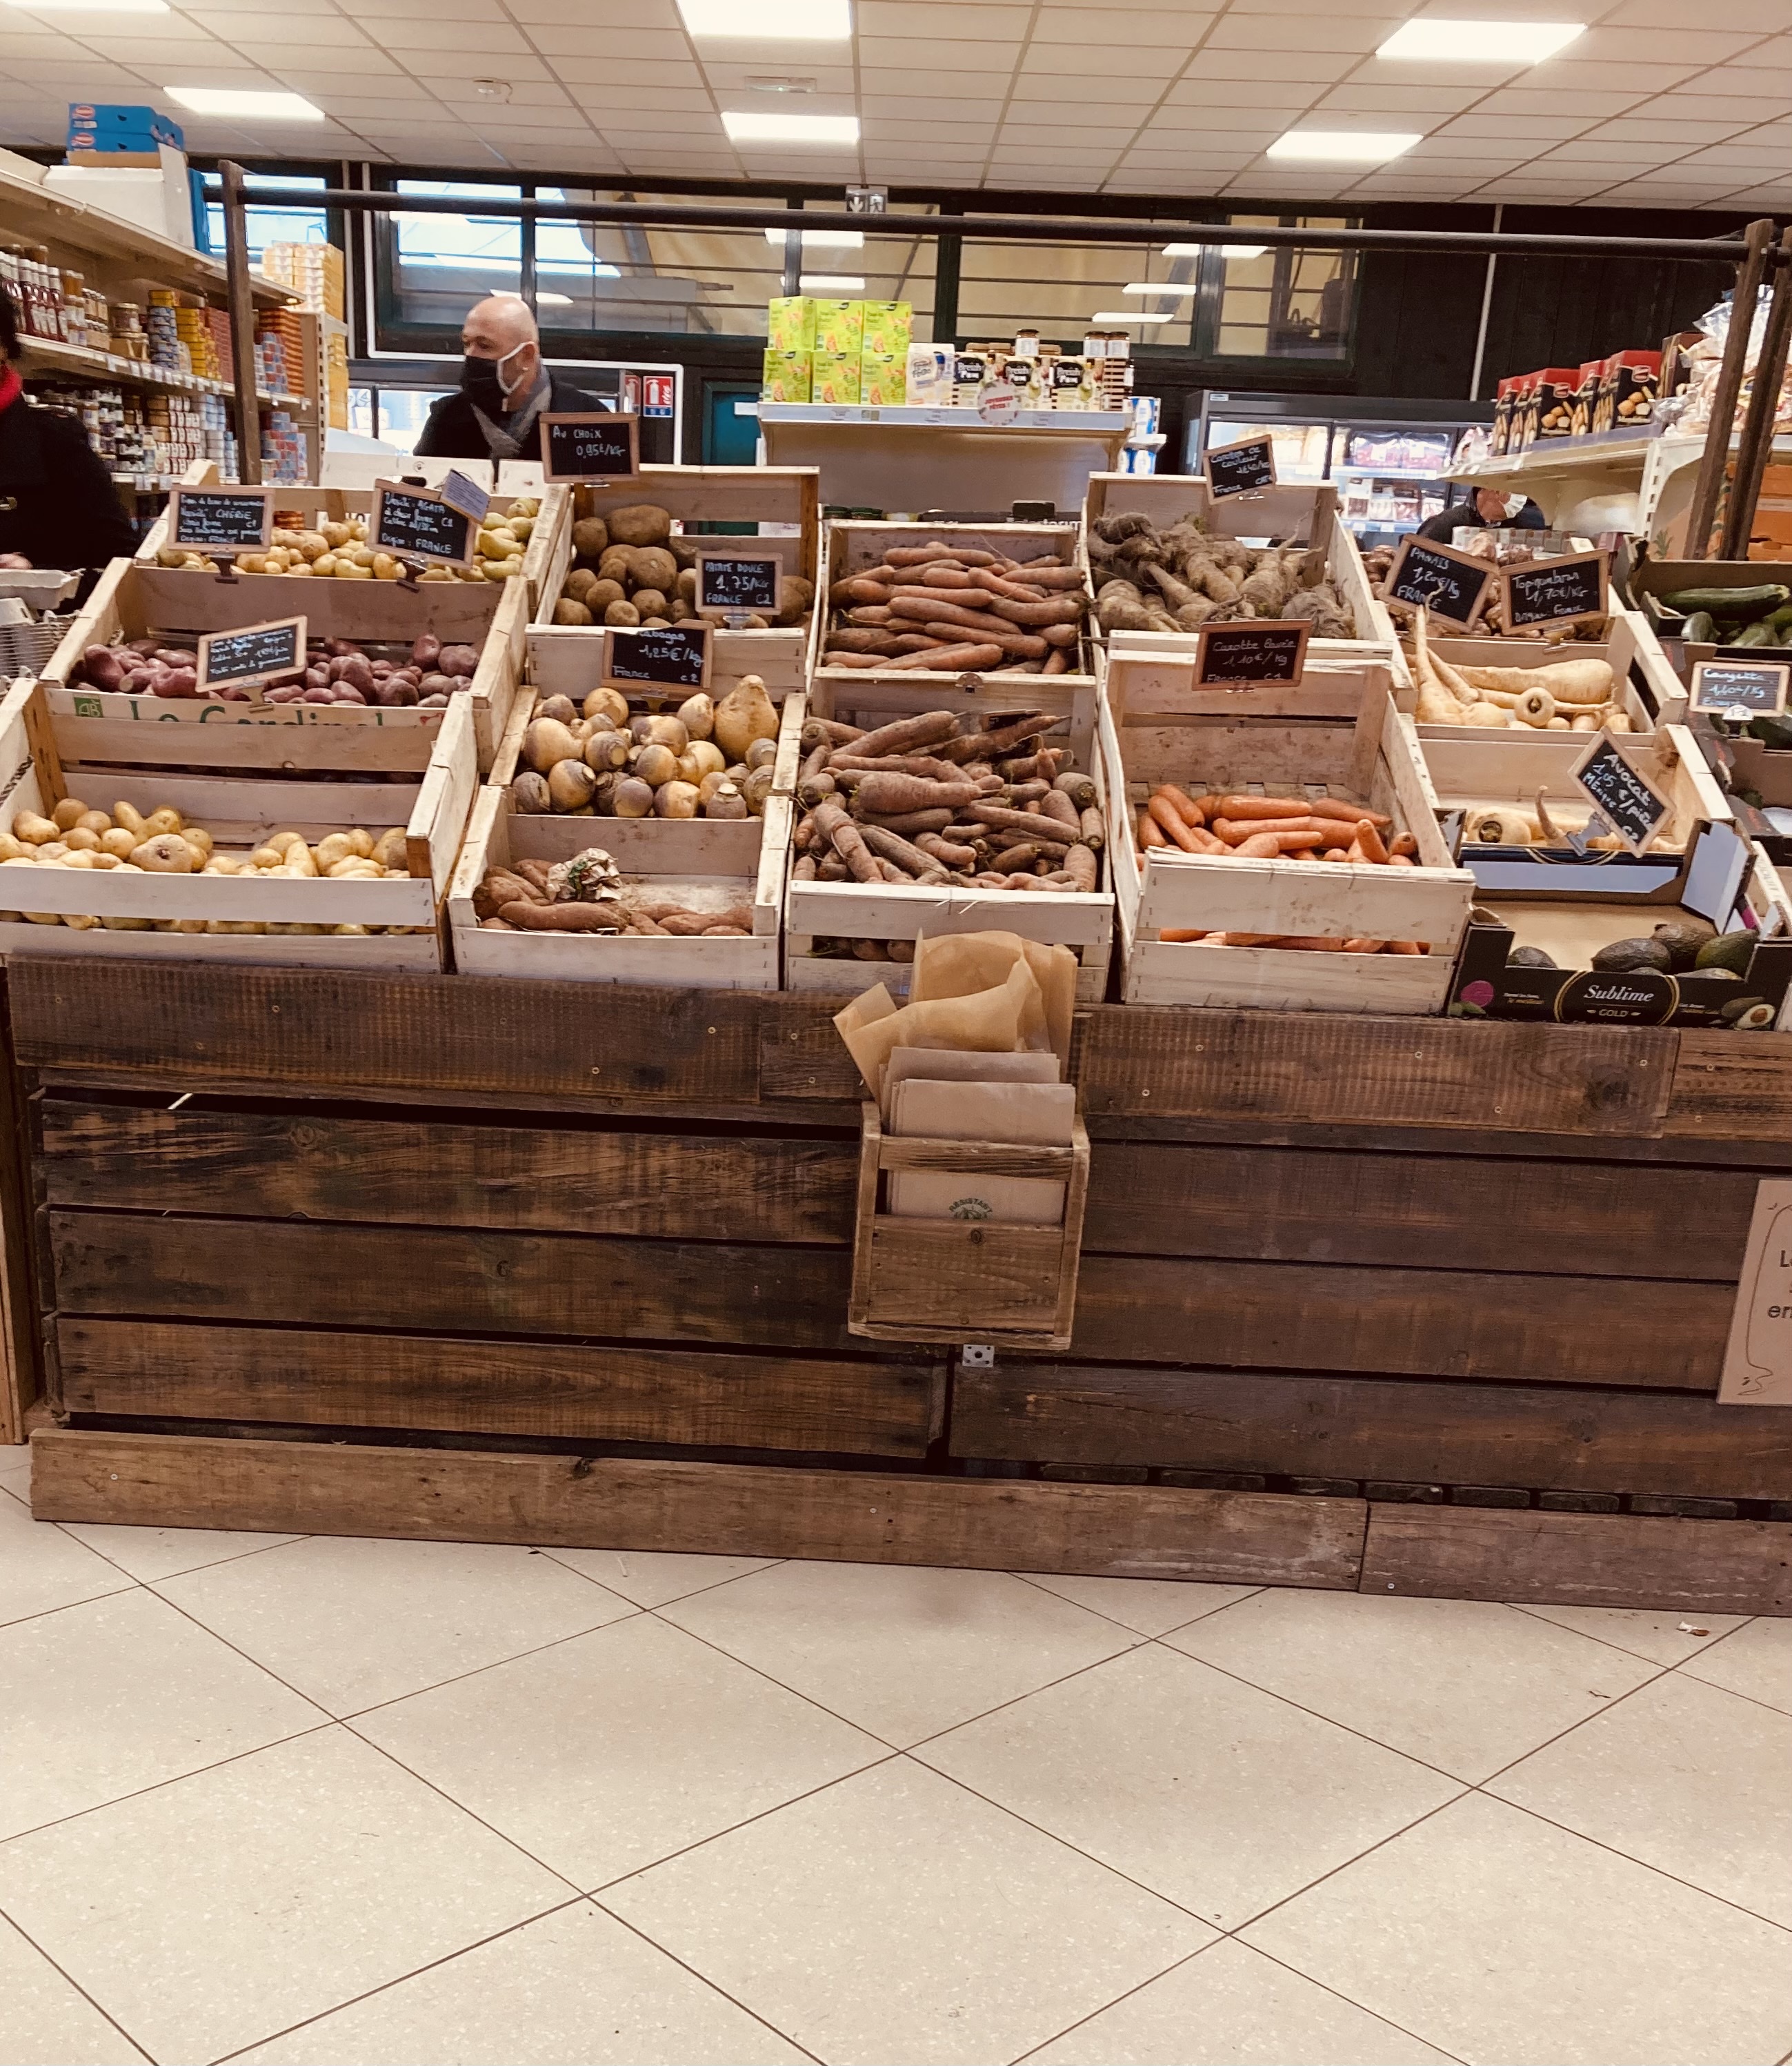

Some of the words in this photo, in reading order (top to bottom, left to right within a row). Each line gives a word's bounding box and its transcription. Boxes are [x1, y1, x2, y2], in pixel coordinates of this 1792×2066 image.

[706, 593, 743, 604] FRANCE
[1397, 585, 1442, 609] FRANE
[1583, 984, 1655, 1002] Sublime
[1598, 1009, 1629, 1017] GOLD
